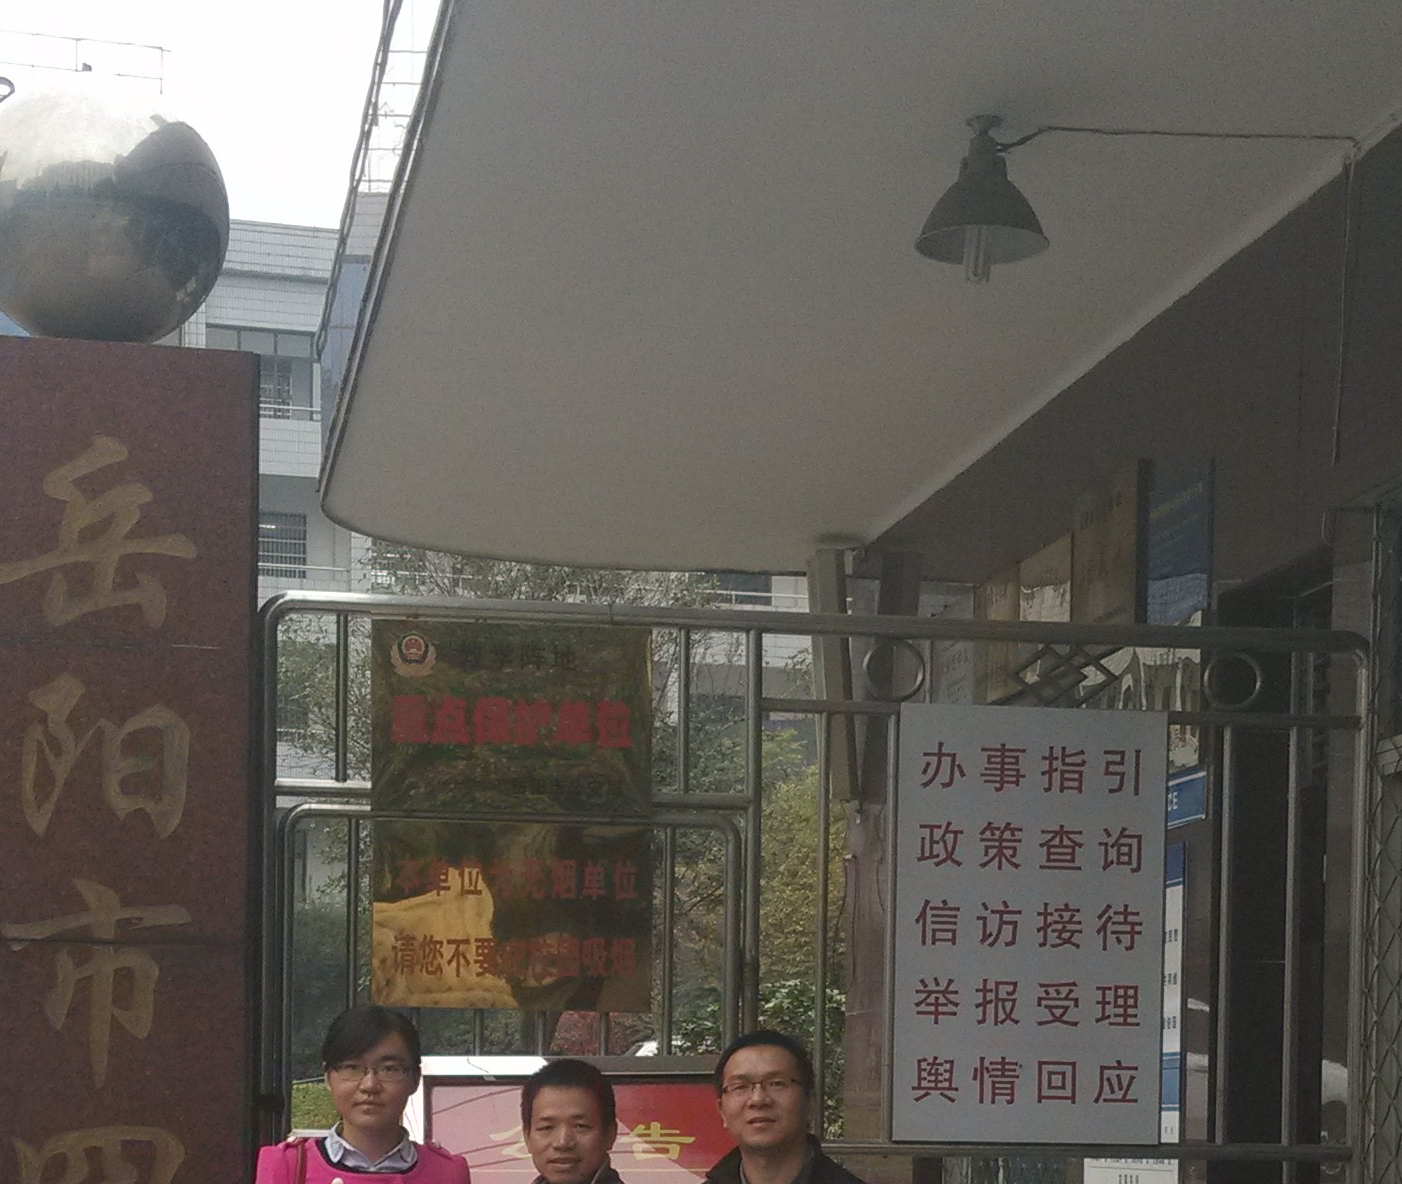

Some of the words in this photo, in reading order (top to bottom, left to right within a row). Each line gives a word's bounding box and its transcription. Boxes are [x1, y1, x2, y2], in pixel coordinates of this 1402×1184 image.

[390, 694, 634, 749] 重点保护单位
[919, 741, 1142, 797] 办事指引
[916, 820, 1144, 874] 政策查询
[914, 899, 1144, 952] 信访接待
[913, 977, 1141, 1028] 举报受理
[911, 1056, 1140, 1105] 舆情回应
